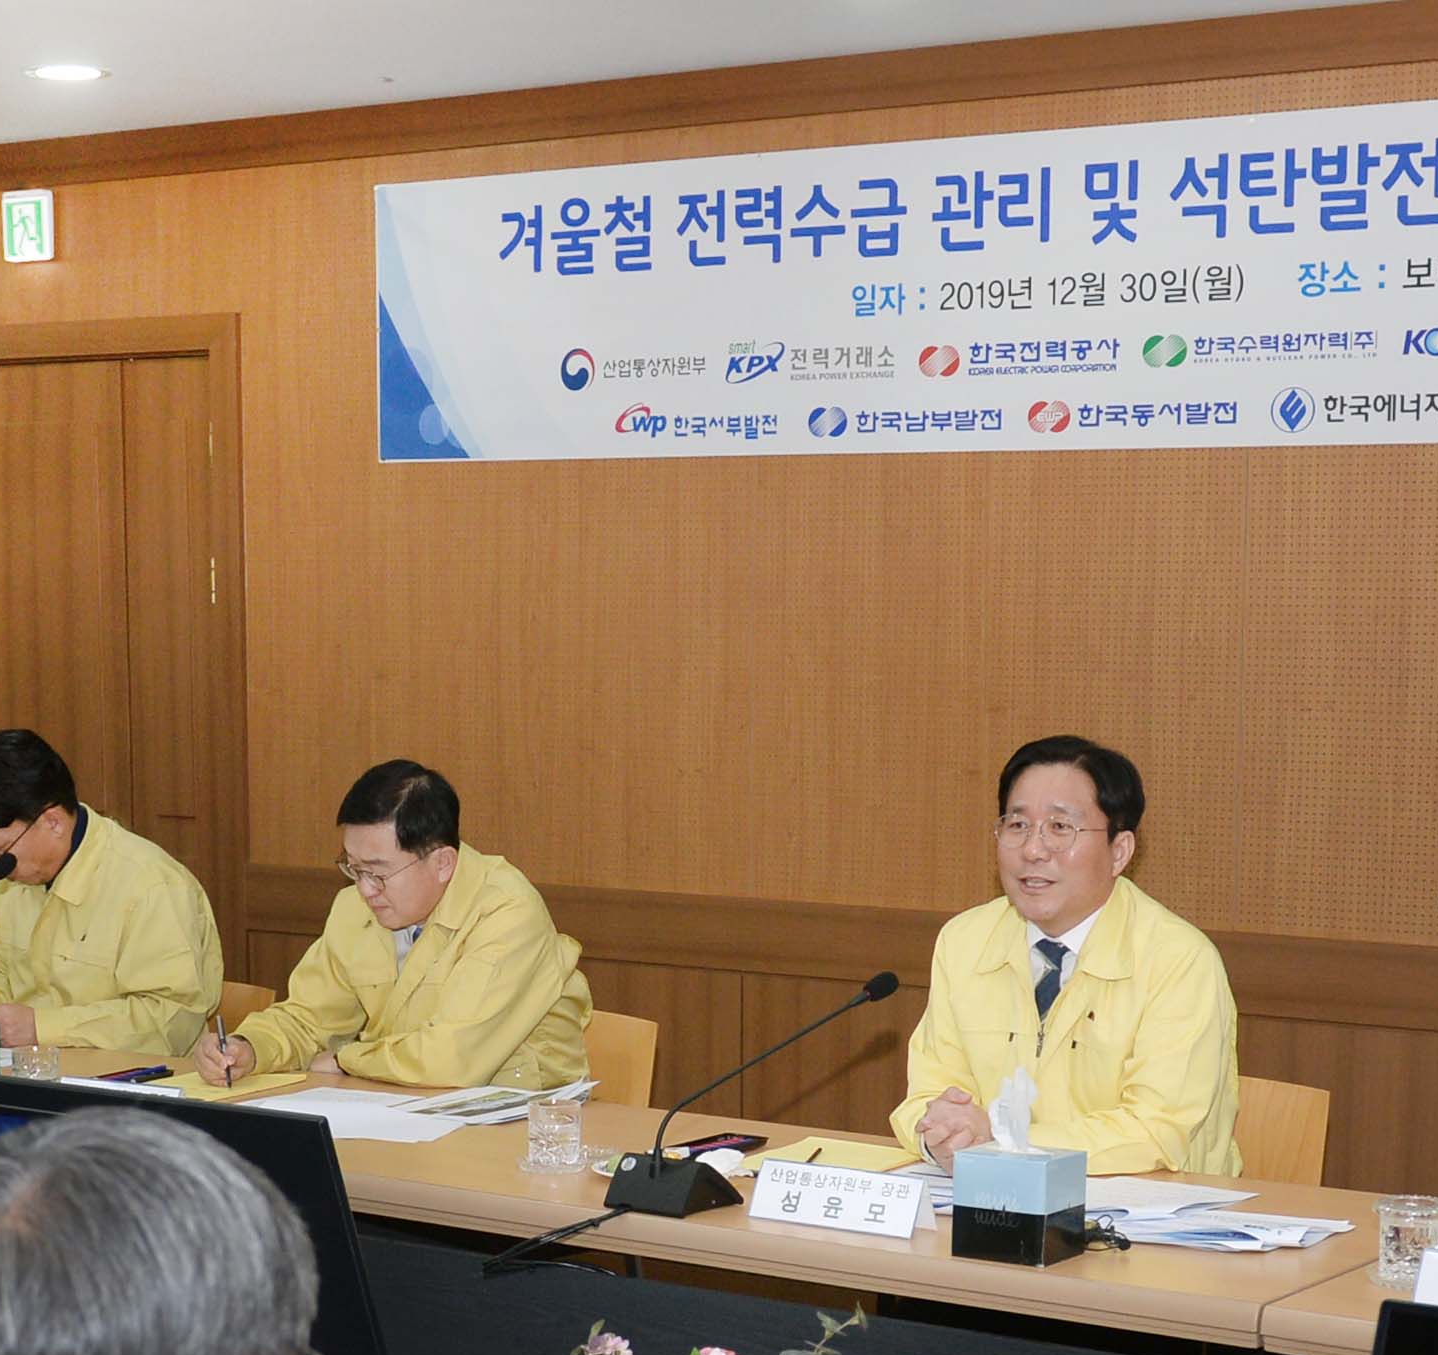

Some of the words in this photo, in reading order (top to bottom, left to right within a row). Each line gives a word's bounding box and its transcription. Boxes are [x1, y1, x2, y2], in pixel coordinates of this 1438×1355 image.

[499, 195, 652, 276] 겨울철
[676, 177, 907, 268] 전력수급
[931, 166, 1052, 253] 관리
[1083, 159, 1139, 245] 및
[852, 283, 906, 318] 일자
[938, 276, 1033, 312] 2019년
[1047, 272, 1107, 307] 12월
[1119, 263, 1246, 305] 30일(월)
[1297, 259, 1362, 299] 장소
[728, 339, 757, 355] smart
[789, 344, 895, 371] 전력거래소
[969, 337, 1121, 365] 한국전력공사
[602, 355, 707, 380] 산업통상자원부
[725, 353, 783, 376] KPX
[790, 372, 817, 382] KOREA
[819, 371, 848, 381] POWER
[850, 370, 895, 380] EXCHANGE
[674, 414, 779, 440] 한국서부발전
[856, 408, 1003, 434] 한국남부발전
[1078, 402, 1239, 428] 한국동서발전
[769, 1166, 874, 1196] 산업통상자원부
[880, 1180, 912, 1201] 장관
